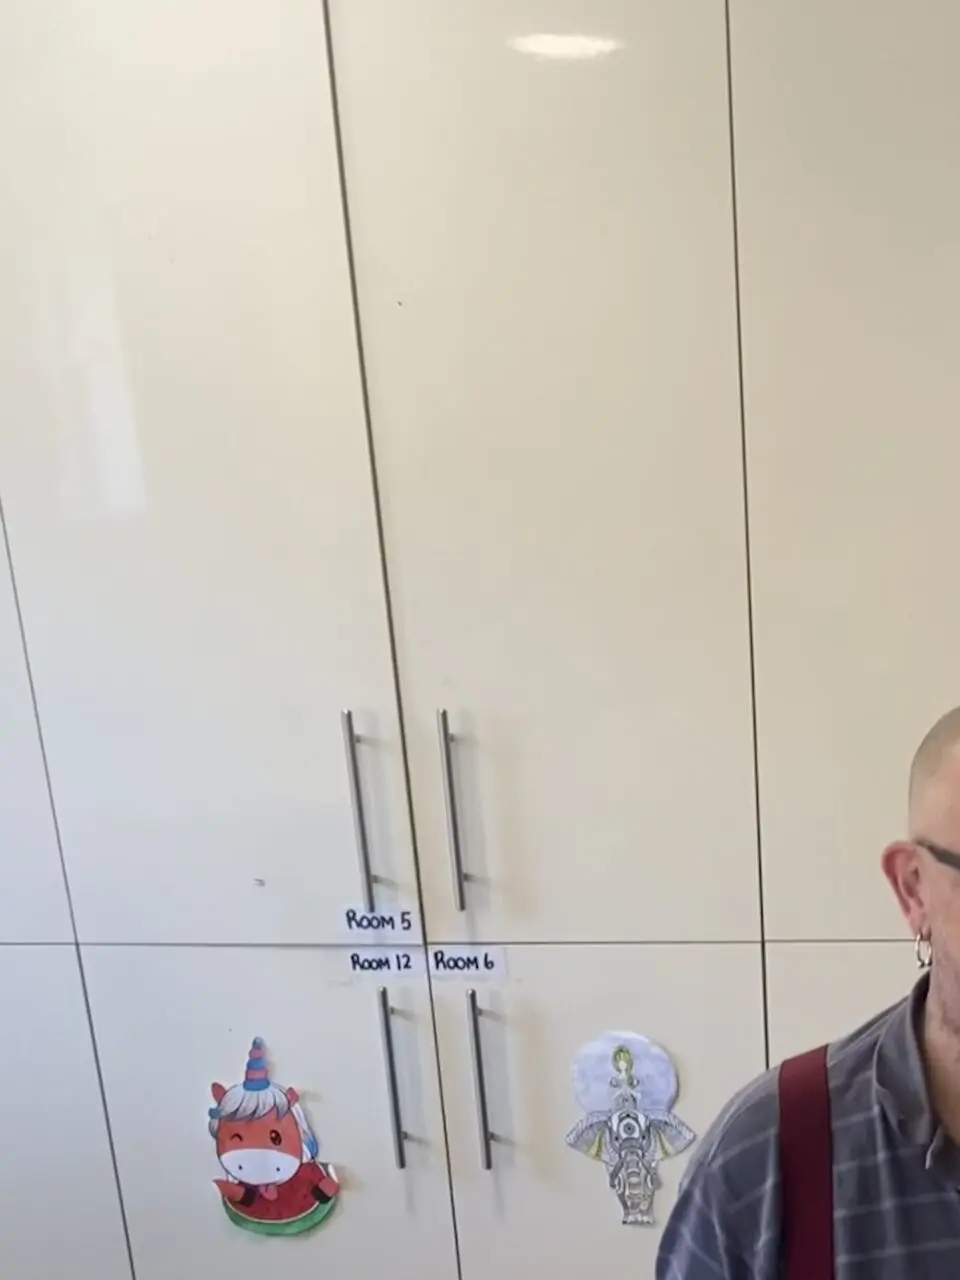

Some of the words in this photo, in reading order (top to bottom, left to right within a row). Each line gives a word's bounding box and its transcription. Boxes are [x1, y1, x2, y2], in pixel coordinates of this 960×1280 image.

[400, 911, 412, 931] 5
[395, 954, 412, 971] 12
[484, 952, 494, 970] 6
